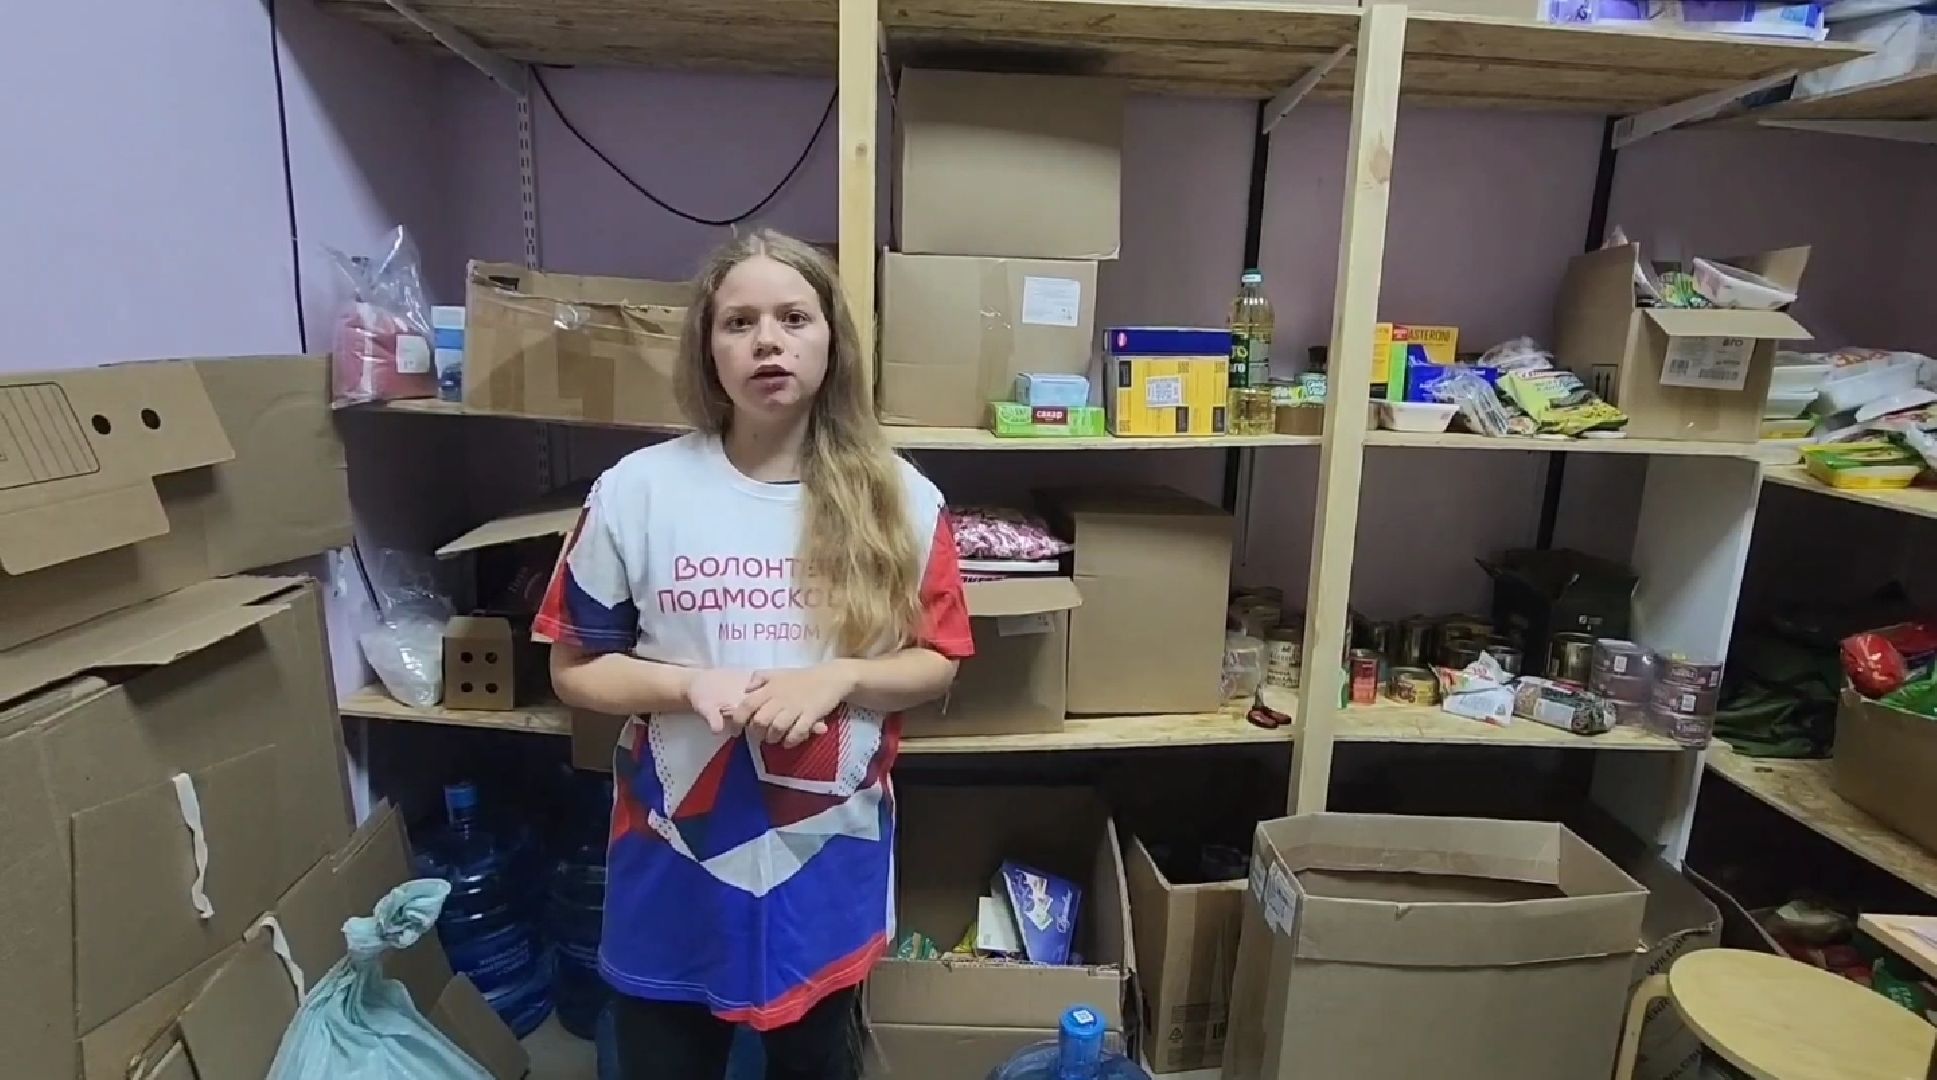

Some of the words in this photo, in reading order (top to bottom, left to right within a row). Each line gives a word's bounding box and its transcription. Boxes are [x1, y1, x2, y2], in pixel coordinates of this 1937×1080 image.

[1408, 328, 1450, 341] ASTERONI
[718, 623, 747, 641] МЫ
[753, 622, 821, 641] РЯДОМ
